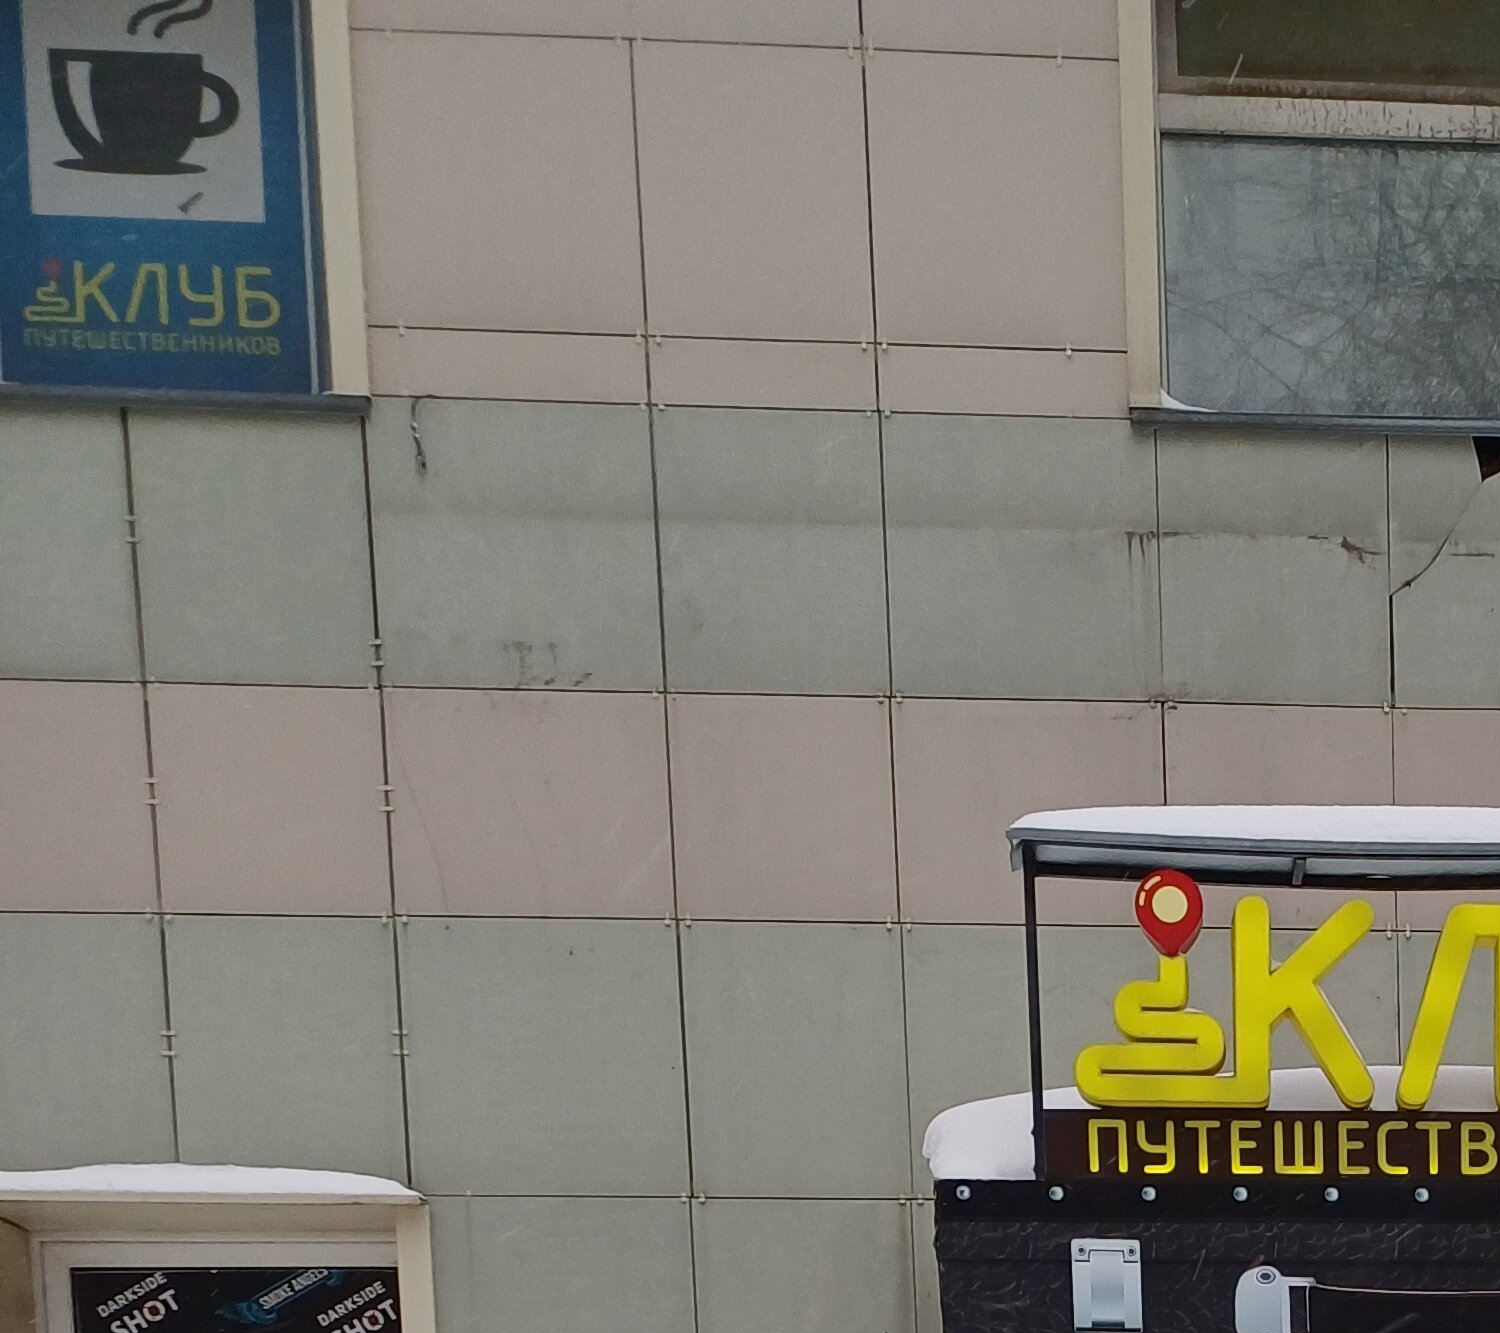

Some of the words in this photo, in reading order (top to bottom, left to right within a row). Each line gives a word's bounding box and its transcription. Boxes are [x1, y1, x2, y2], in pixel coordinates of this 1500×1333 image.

[73, 260, 281, 328] КЛУБ
[24, 329, 281, 355] ПУТЕШЕСТВЕННИКОВ
[96, 1271, 168, 1318] DARKSIDE
[317, 1281, 386, 1327] DARKSIDE
